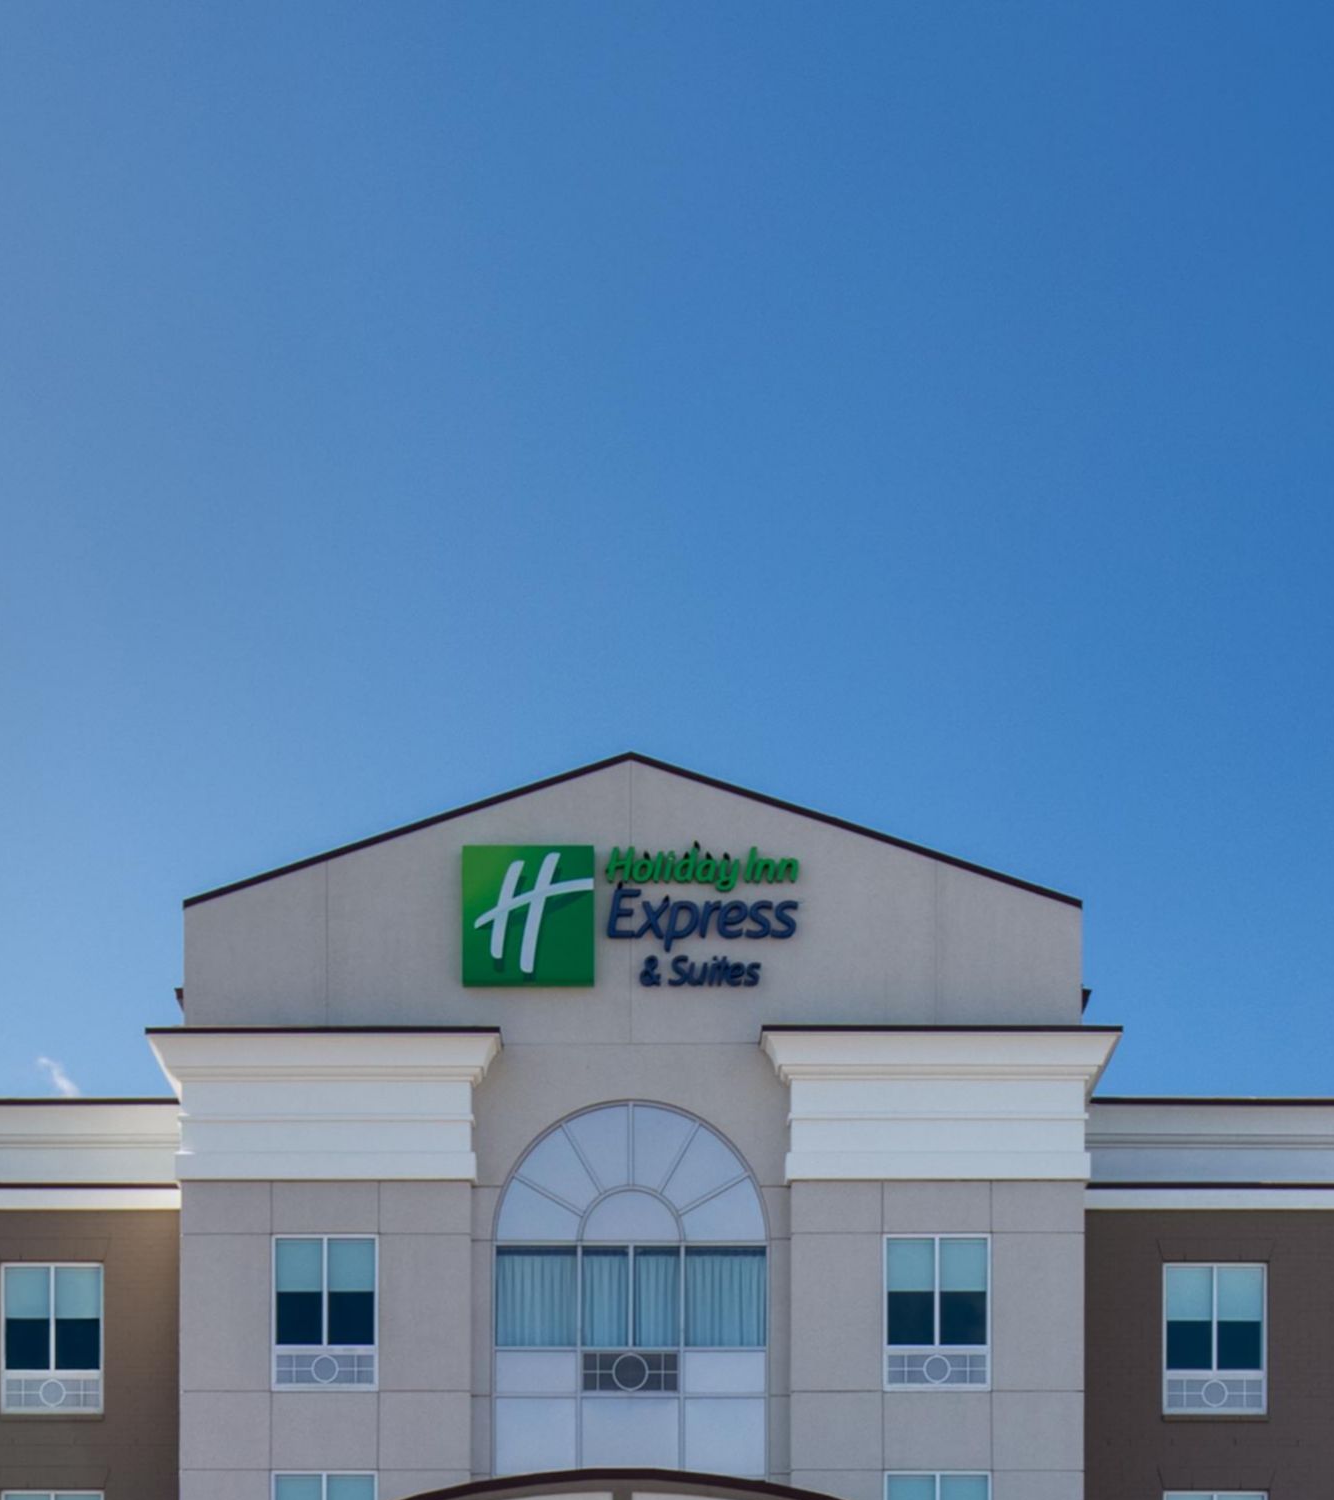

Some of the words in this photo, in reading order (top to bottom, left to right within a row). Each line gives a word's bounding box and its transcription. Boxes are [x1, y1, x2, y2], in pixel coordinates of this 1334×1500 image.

[607, 845, 740, 893] Holiday
[743, 845, 799, 884] Inn
[607, 888, 799, 953] Express
[639, 955, 662, 987] &
[668, 955, 761, 987] Suites
